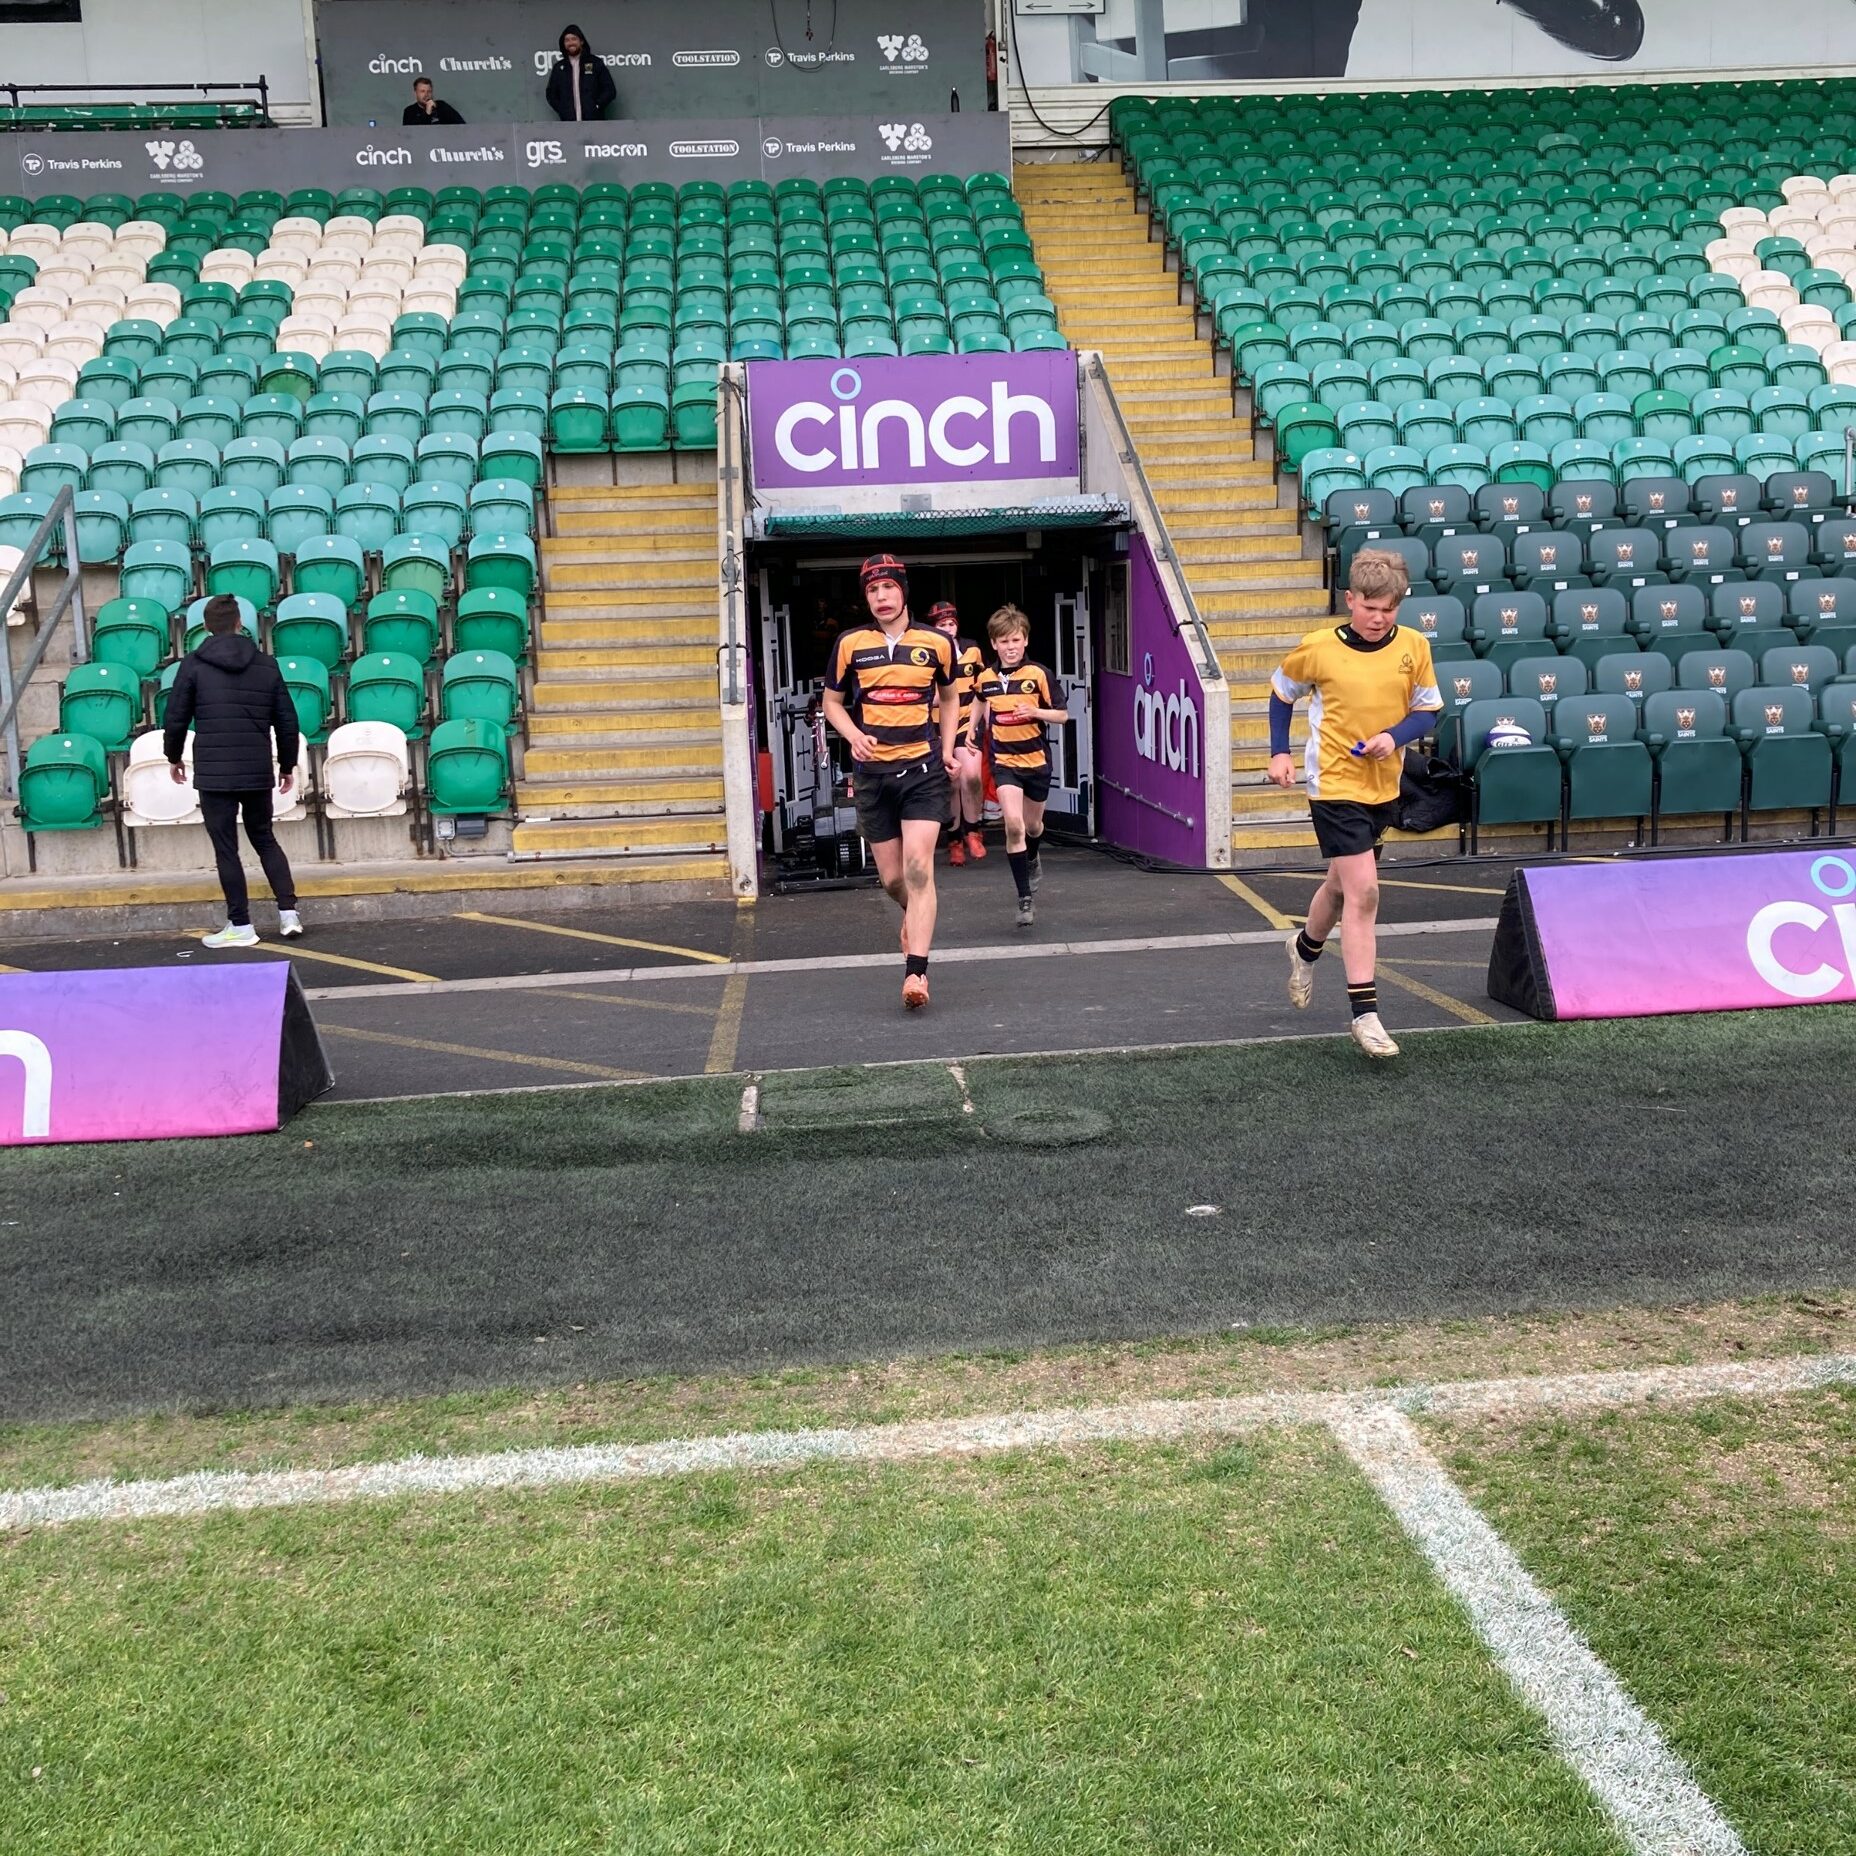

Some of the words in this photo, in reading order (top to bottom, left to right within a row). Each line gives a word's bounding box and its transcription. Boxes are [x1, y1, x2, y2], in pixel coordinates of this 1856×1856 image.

[369, 53, 422, 73] cinch
[440, 56, 512, 71] Church's
[676, 54, 736, 63] TOOLSTATION
[788, 53, 816, 62] Travis
[819, 52, 855, 62] Perkins
[430, 147, 504, 162] Church's
[526, 141, 562, 167] grs
[584, 144, 647, 157] macron
[673, 144, 735, 153] TOOLSTATION
[786, 142, 815, 152] Travis
[818, 142, 855, 151] Perkins
[356, 145, 412, 165] cinch
[48, 160, 79, 169] Travis
[82, 159, 122, 168] Perkins
[775, 368, 1056, 472] cinch
[1134, 652, 1198, 778] cinch
